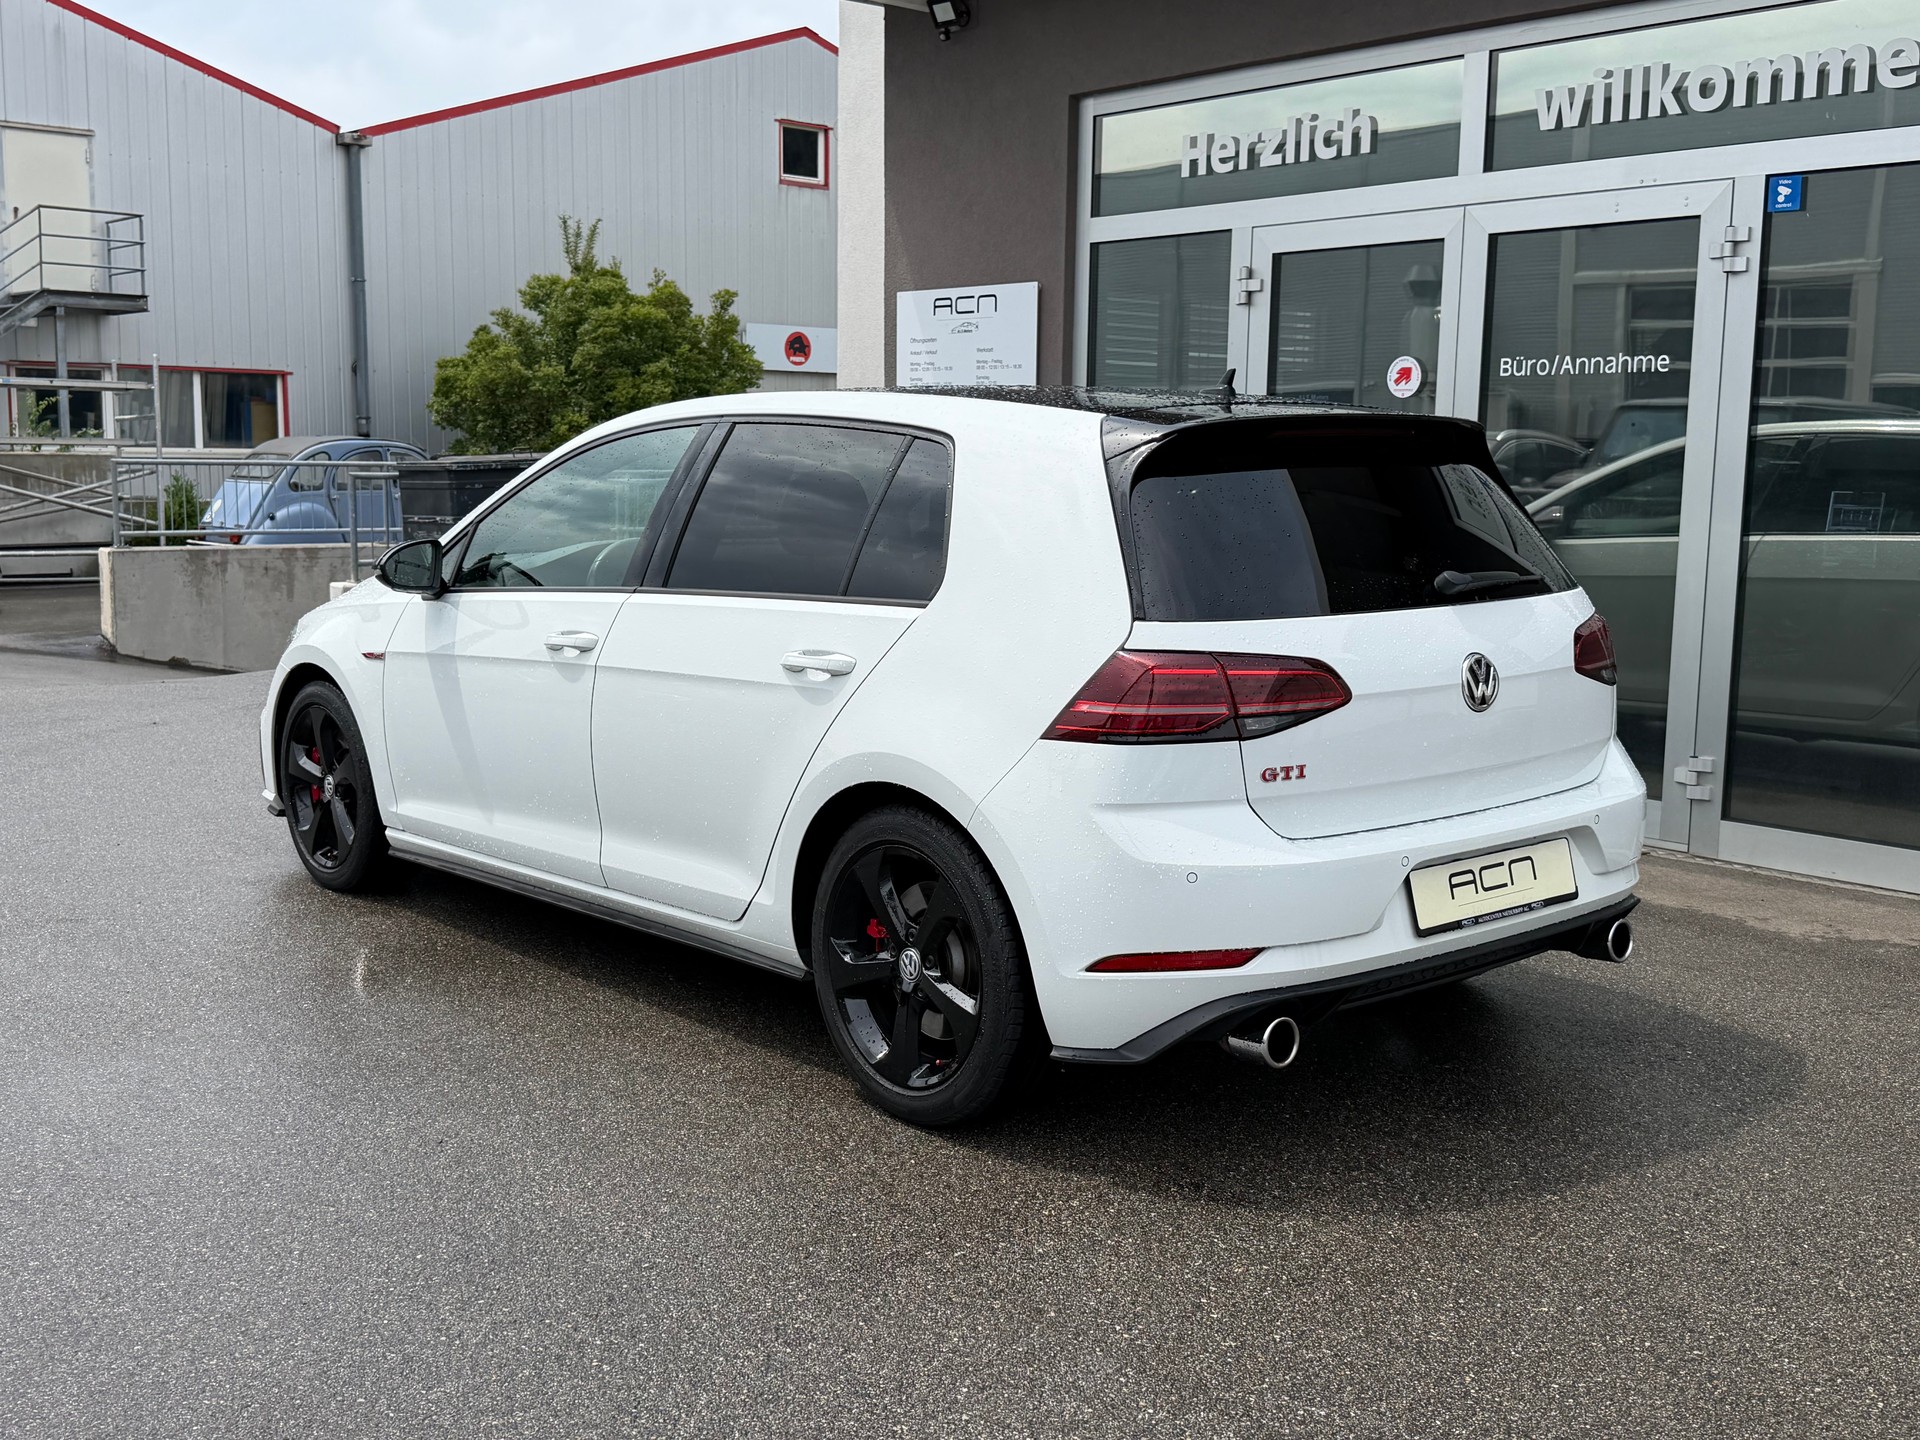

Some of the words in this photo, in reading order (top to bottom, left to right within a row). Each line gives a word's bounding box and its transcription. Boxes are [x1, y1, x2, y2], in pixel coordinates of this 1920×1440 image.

[1181, 107, 1372, 178] Herzlich
[1500, 353, 1670, 377] Büro/Annahme
[1260, 764, 1307, 783] GTI
